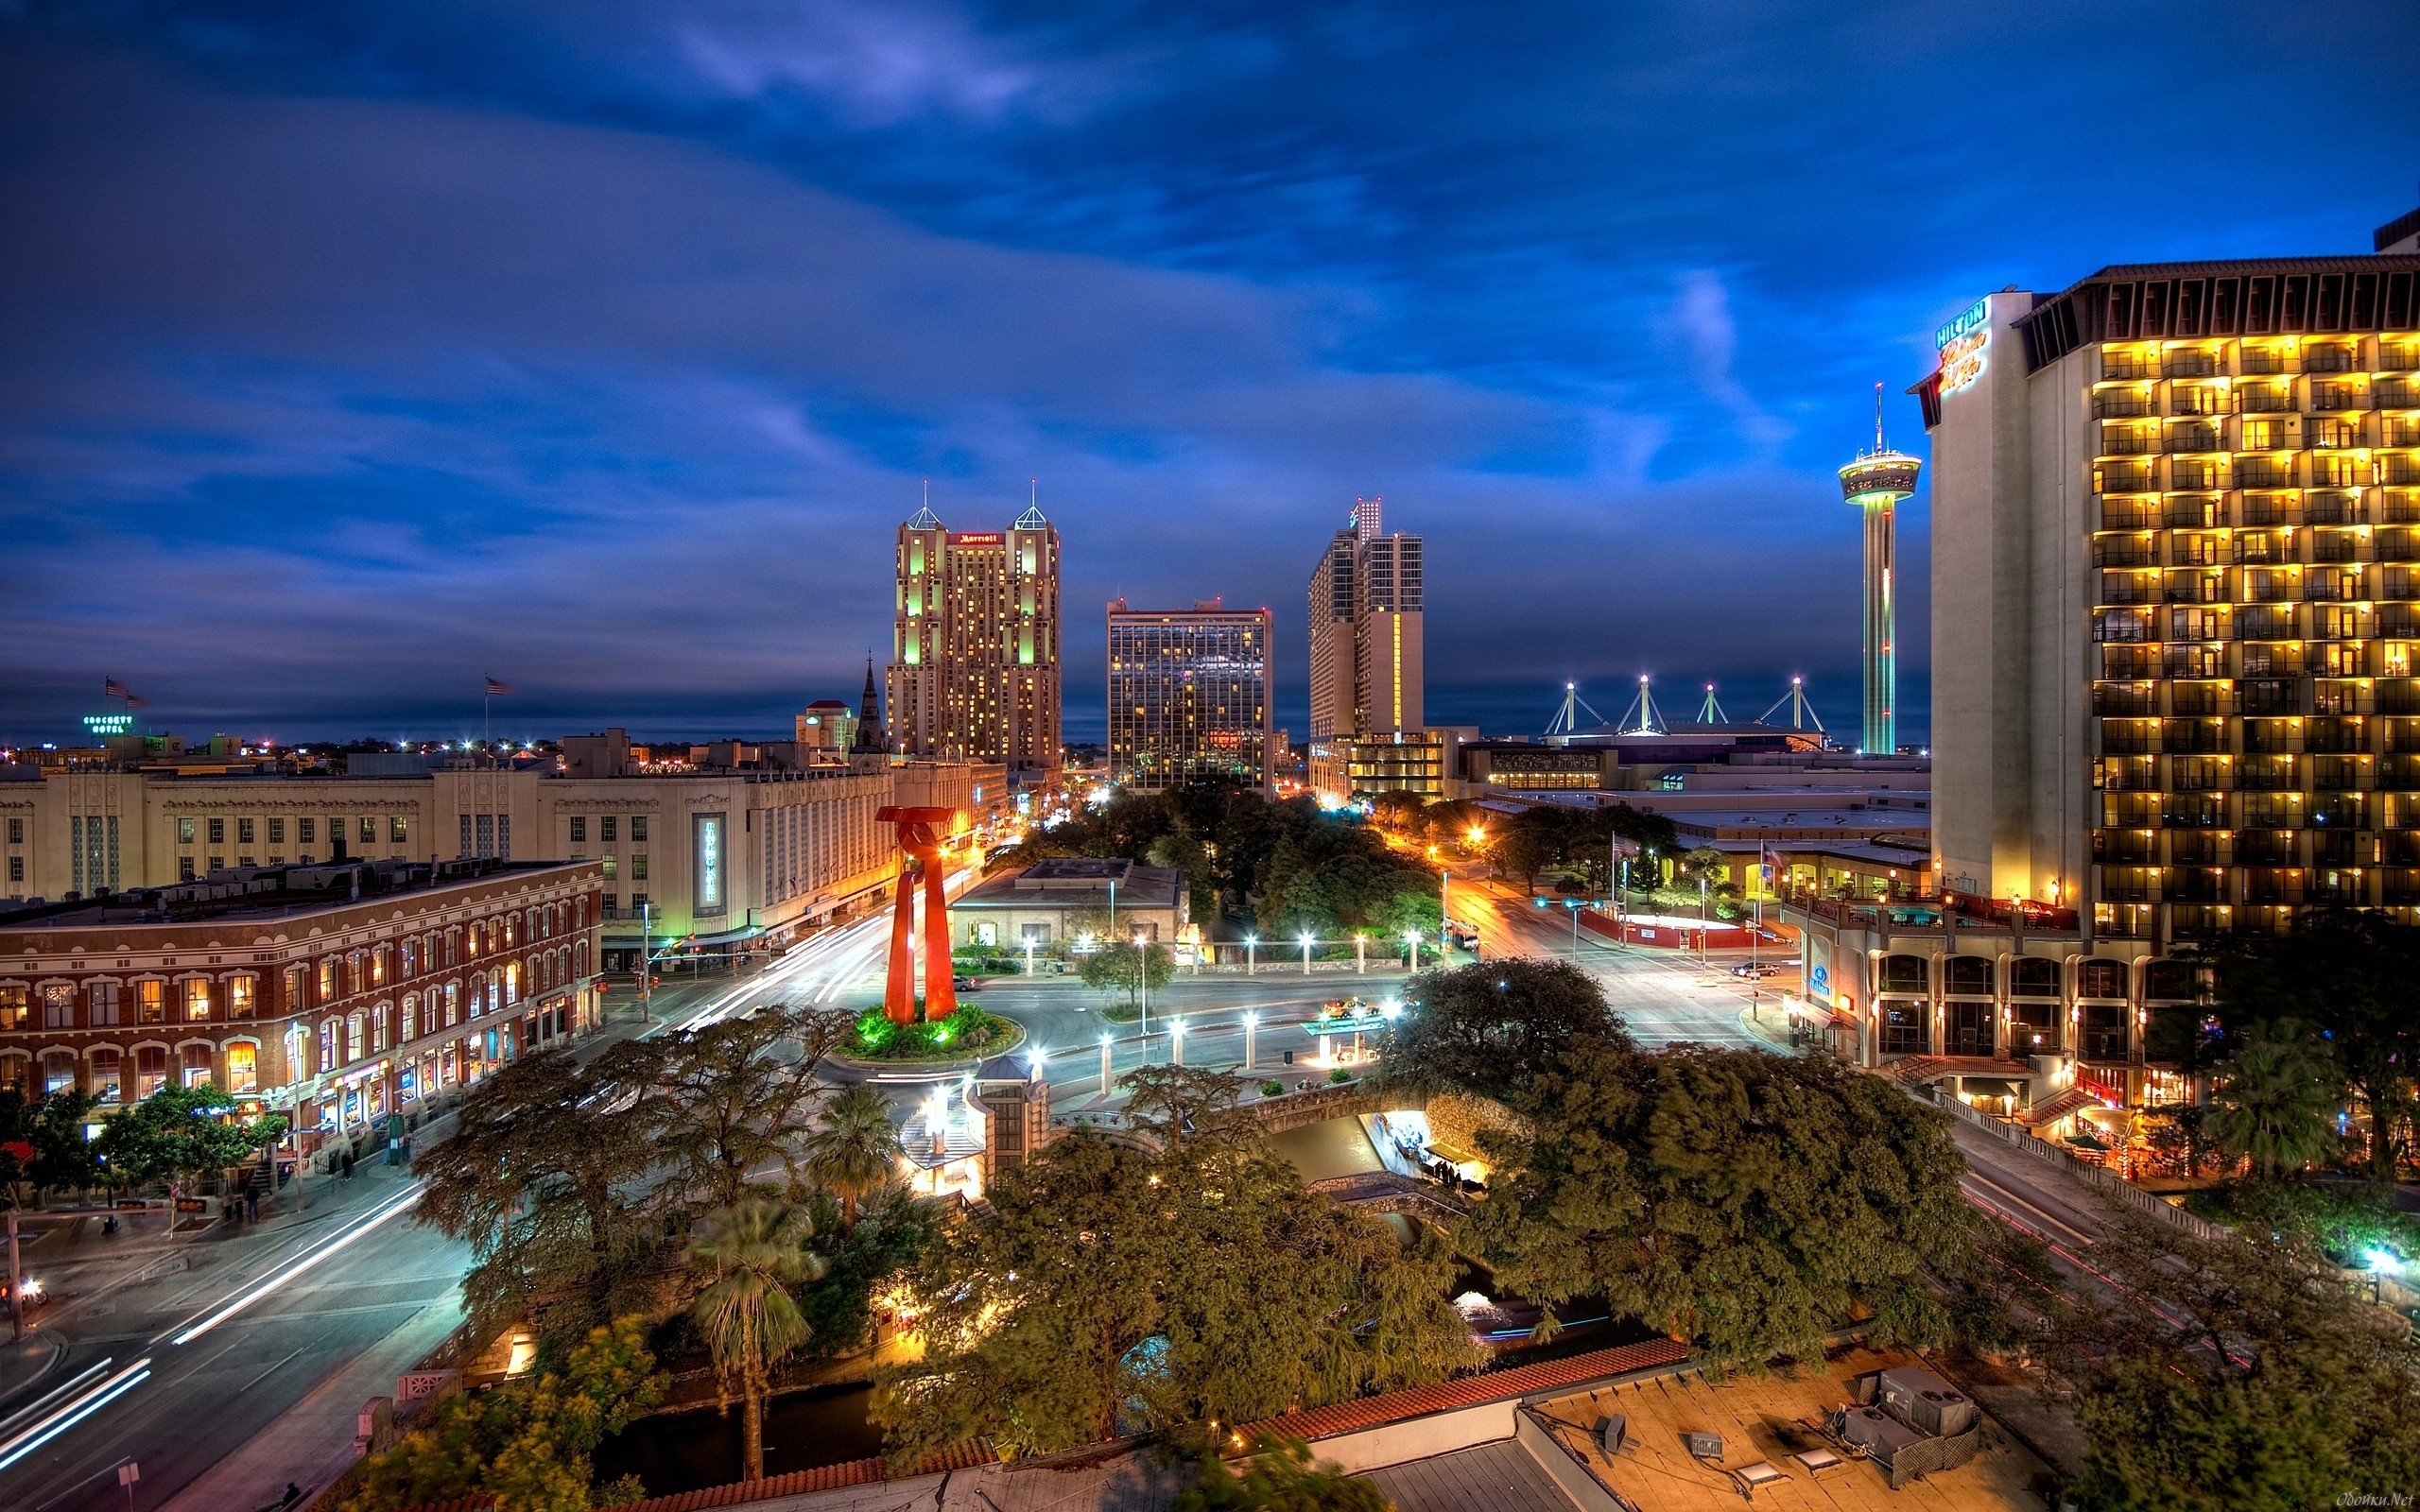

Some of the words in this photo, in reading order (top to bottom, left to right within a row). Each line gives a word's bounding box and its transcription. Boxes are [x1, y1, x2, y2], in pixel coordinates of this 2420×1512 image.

[1936, 301, 1985, 349] HILTON
[959, 534, 997, 543] Marriott
[83, 715, 132, 725] CROCKETT
[92, 725, 124, 733] HOTEL
[1809, 977, 1829, 995] Hilton
